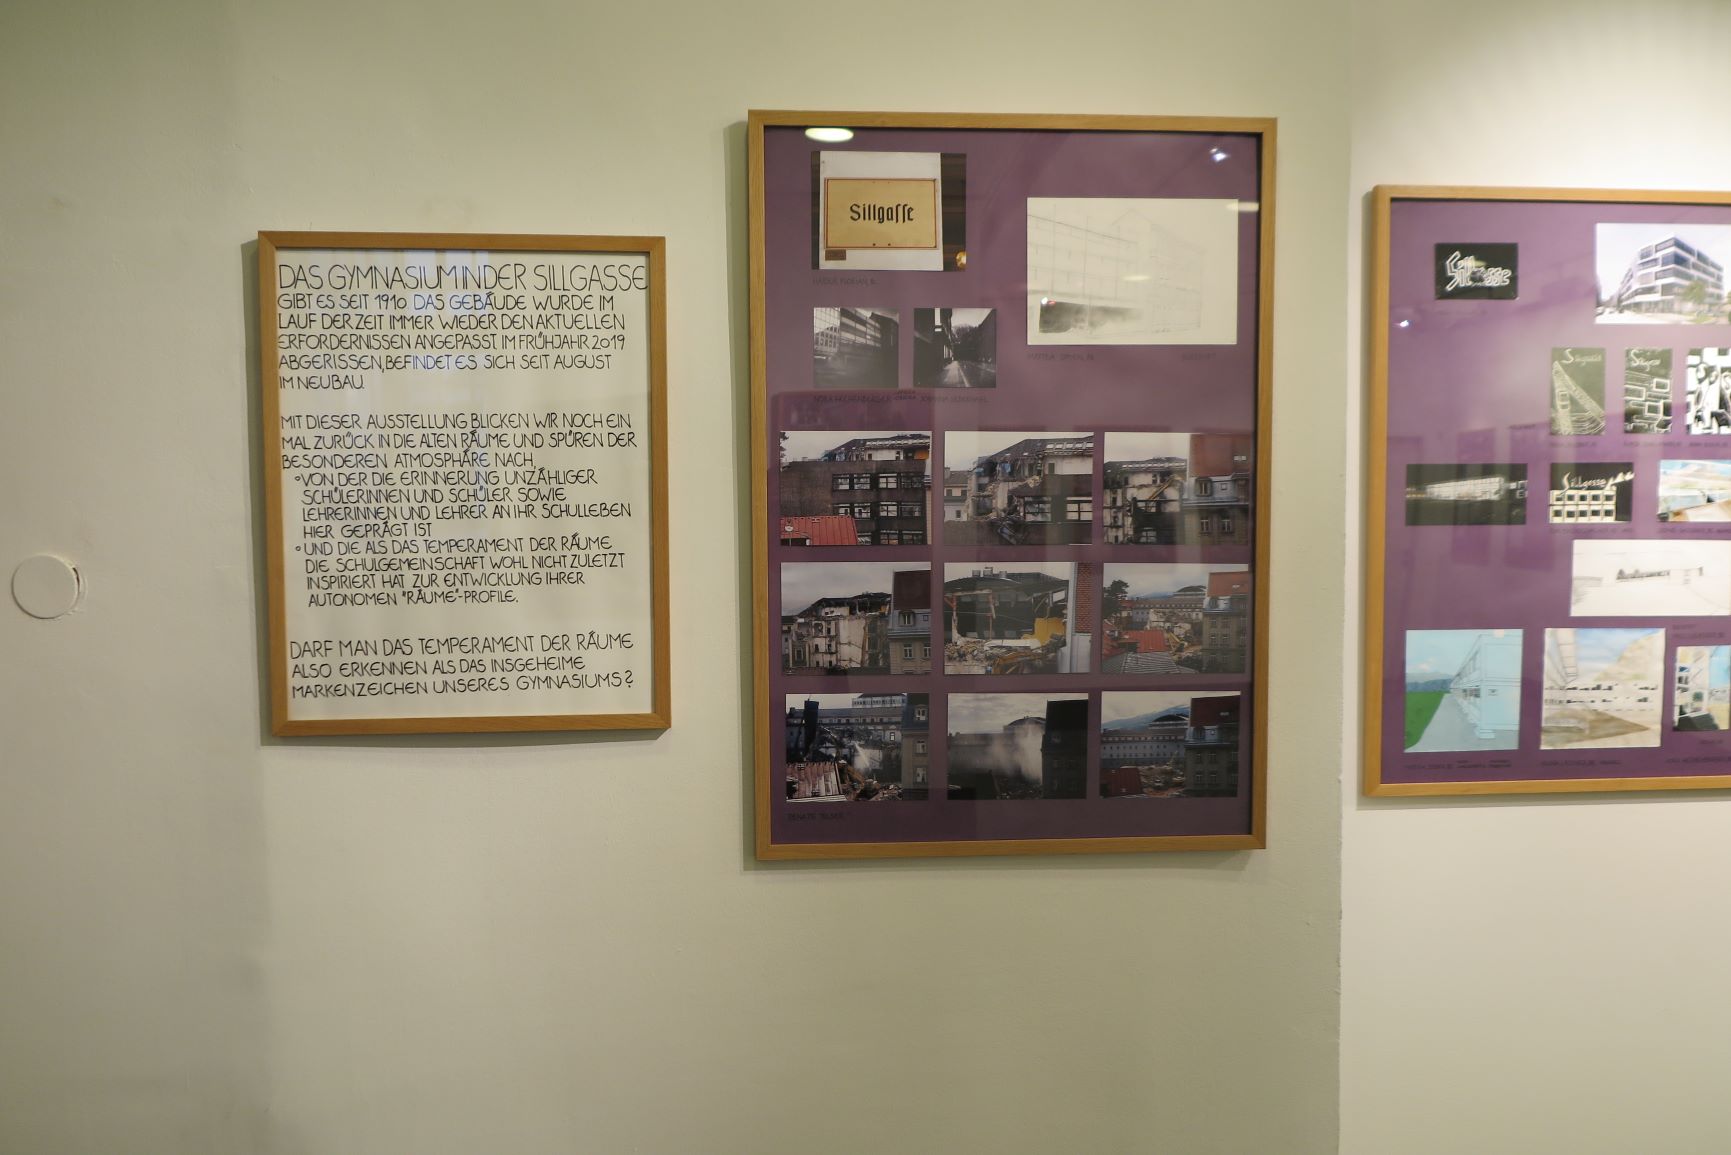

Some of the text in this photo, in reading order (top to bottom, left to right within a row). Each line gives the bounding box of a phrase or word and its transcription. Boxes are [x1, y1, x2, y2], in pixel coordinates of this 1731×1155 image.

[278, 264, 648, 291] DAS GYMNASIUM IN DER SILLGASSE
[278, 294, 312, 310] GIBT
[317, 294, 335, 309] ES
[339, 294, 369, 310] SEIT
[413, 295, 445, 310] DAS
[449, 291, 527, 310] GEBÄUDE
[532, 294, 593, 311] WURDE
[599, 295, 614, 311] IM
[278, 314, 625, 330] LAUF DER ZEIT IMMER WIEDER DEN AKTUELLEN
[278, 334, 411, 350] ERFORDERNISSEN
[502, 335, 516, 349] IM
[518, 332, 588, 349] FRÜHJAHR
[592, 336, 625, 350] 2019
[385, 355, 452, 370] BEFINDET
[455, 355, 478, 370] ES
[483, 355, 516, 370] SICH
[520, 355, 550, 369] SEIT
[553, 355, 612, 369] AUGUST
[279, 376, 294, 389] IM
[281, 413, 631, 429] MIT DIESER AUSSTELLUNG BLICKEN WIR NOCH EIN
[282, 429, 637, 449] MAL ZURÜCK IN DIE ALTEN RÄUME UND SPÜREN DER
[282, 454, 387, 469] BESONDEREN
[394, 448, 490, 468] ATMOSPHÄRE
[302, 466, 597, 486] VON DER DIE ERINNERUNG UNZÄHLIGER
[302, 486, 567, 504] SCHÜLERINNEN UND SCHÜLER SOWIE
[302, 502, 631, 521] LEHRERINNEN UND LEHRER AN IHR SCHULLEBEN
[303, 524, 333, 539] HIER
[341, 521, 410, 538] GEPRÄGT
[304, 532, 612, 555] UND DIE ALS DAS TEMPERAMENT DER RÄUME
[306, 553, 625, 573] DIE SCHULGEMEINSCHAFT WOHL NICHT ZULETZT
[307, 571, 585, 590] INSPIRIERT HAT ZUR ENTWICKLUNG IHRER
[308, 591, 397, 607] AUTONOMEN
[290, 631, 633, 659] DARF MAN DAS TEMPERAMENT DER RÄUME
[292, 656, 585, 678] ALSO ERKENNEN ALS DAS INSGEHEIME
[292, 682, 428, 699] MARKENZEICHEN
[433, 677, 509, 694] UNSERES
